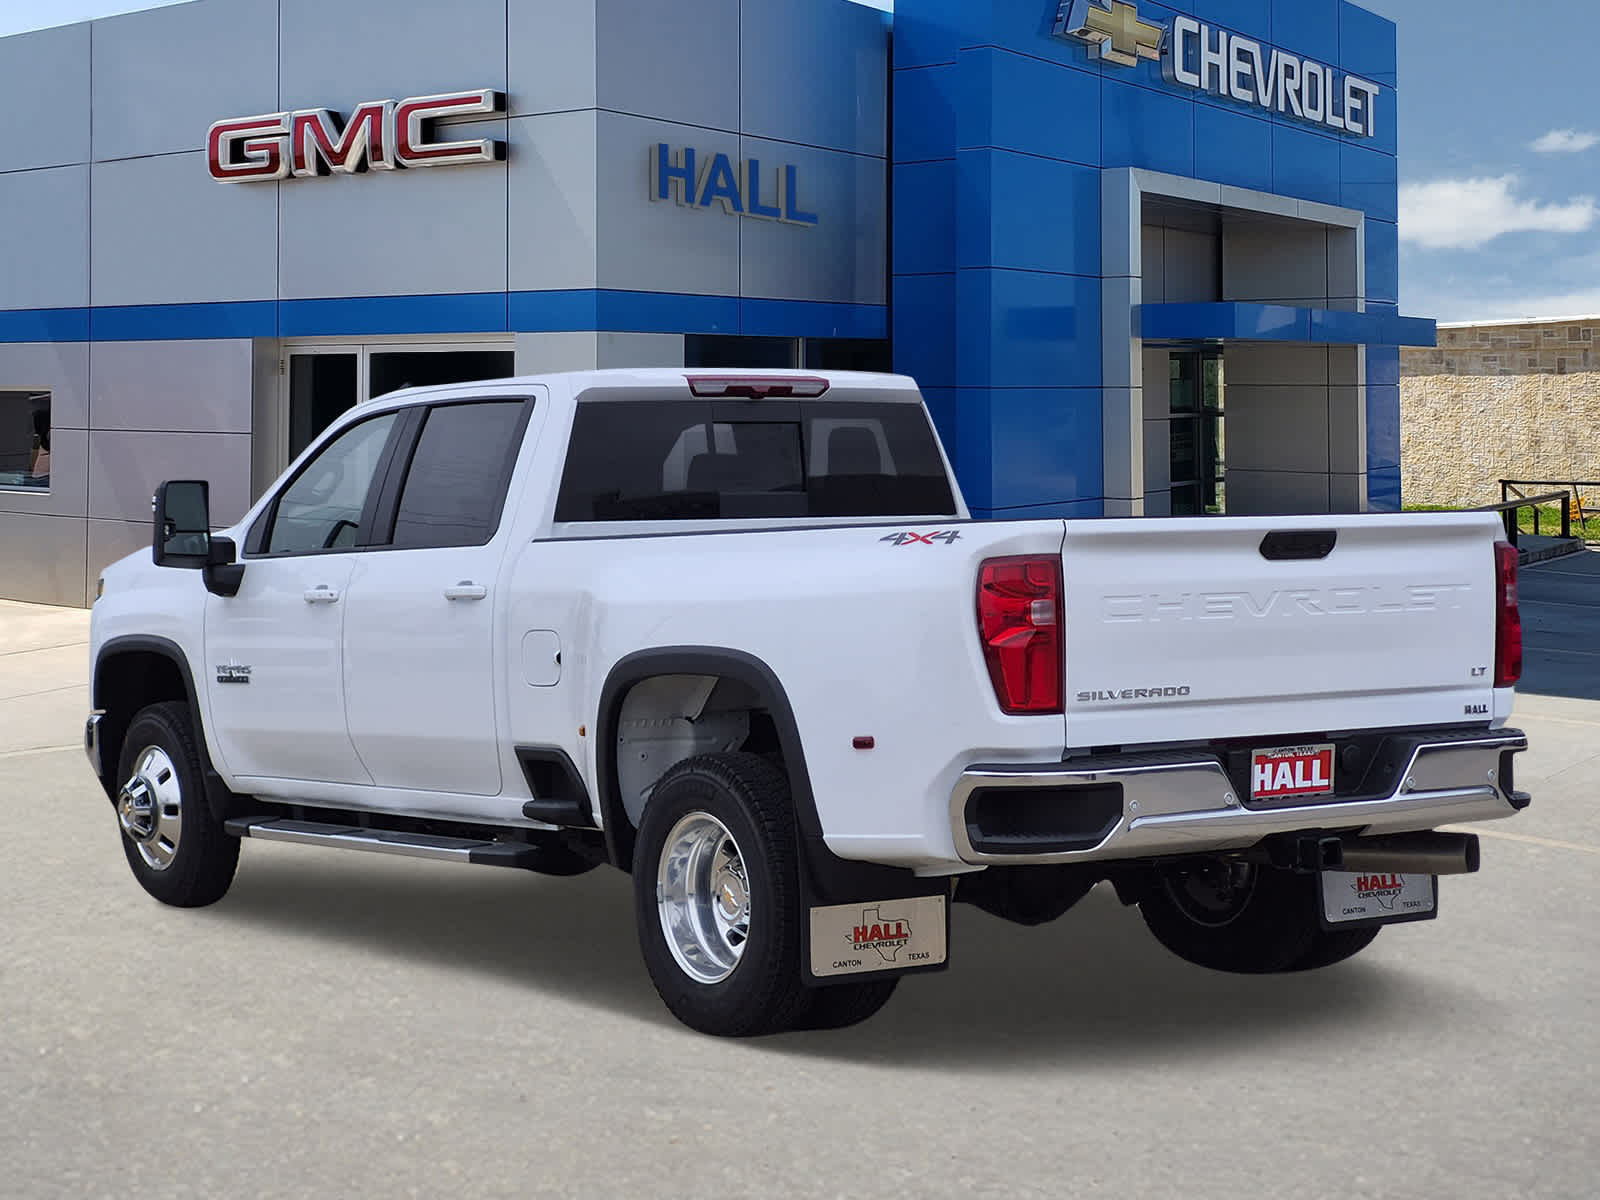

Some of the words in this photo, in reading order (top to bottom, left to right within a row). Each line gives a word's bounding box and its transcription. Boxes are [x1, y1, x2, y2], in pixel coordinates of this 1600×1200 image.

[1173, 15, 1380, 137] CHEVROLET
[206, 88, 506, 184] GMC
[652, 142, 819, 226] HALL
[1101, 583, 1472, 623] CHEVROLET
[1471, 666, 1487, 677] LT
[1077, 686, 1191, 702] SILVERADO
[1464, 704, 1489, 715] HALL
[1254, 759, 1329, 792] HALL
[1357, 872, 1402, 892] HALL
[1358, 888, 1402, 899] CHEVROLET
[1342, 907, 1366, 915] CANTON
[853, 922, 909, 943] HALL
[853, 939, 908, 951] CHEVROLET
[832, 959, 862, 969] CANTON
[908, 951, 930, 961] TEXAS
